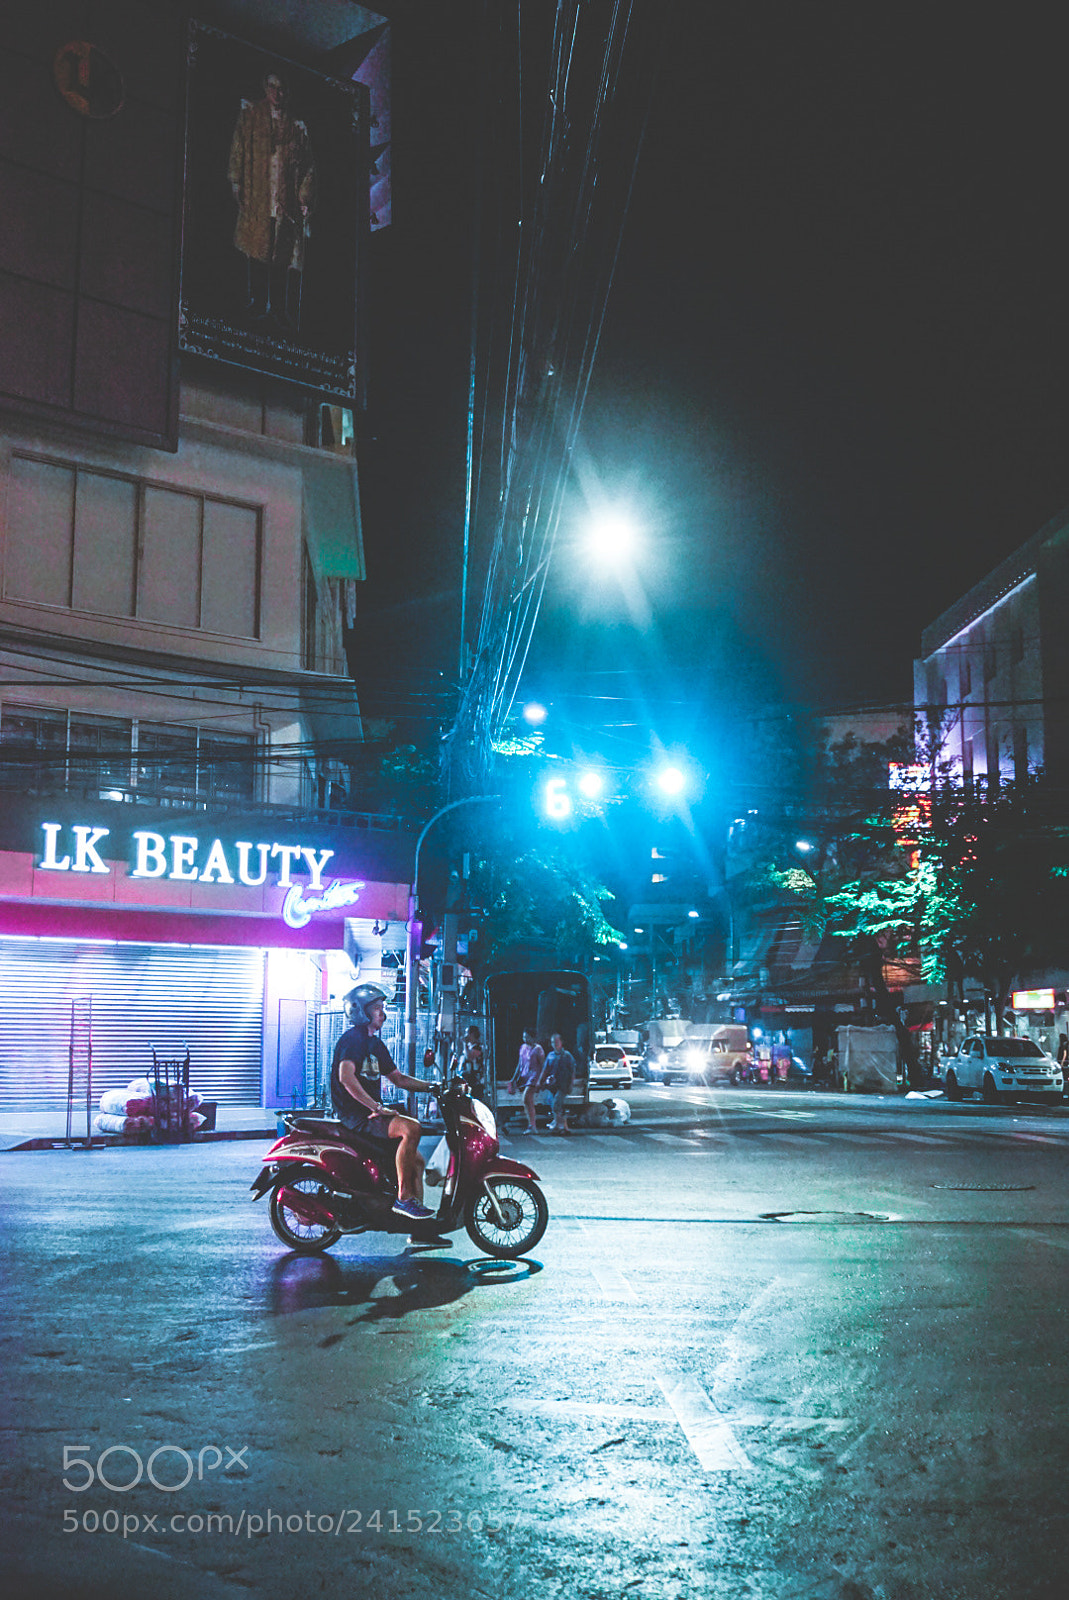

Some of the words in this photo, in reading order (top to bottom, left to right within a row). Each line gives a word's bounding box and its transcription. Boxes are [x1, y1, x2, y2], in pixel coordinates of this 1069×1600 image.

[546, 779, 570, 817] 6
[39, 822, 110, 873] LK
[132, 831, 334, 890] BEAUTY
